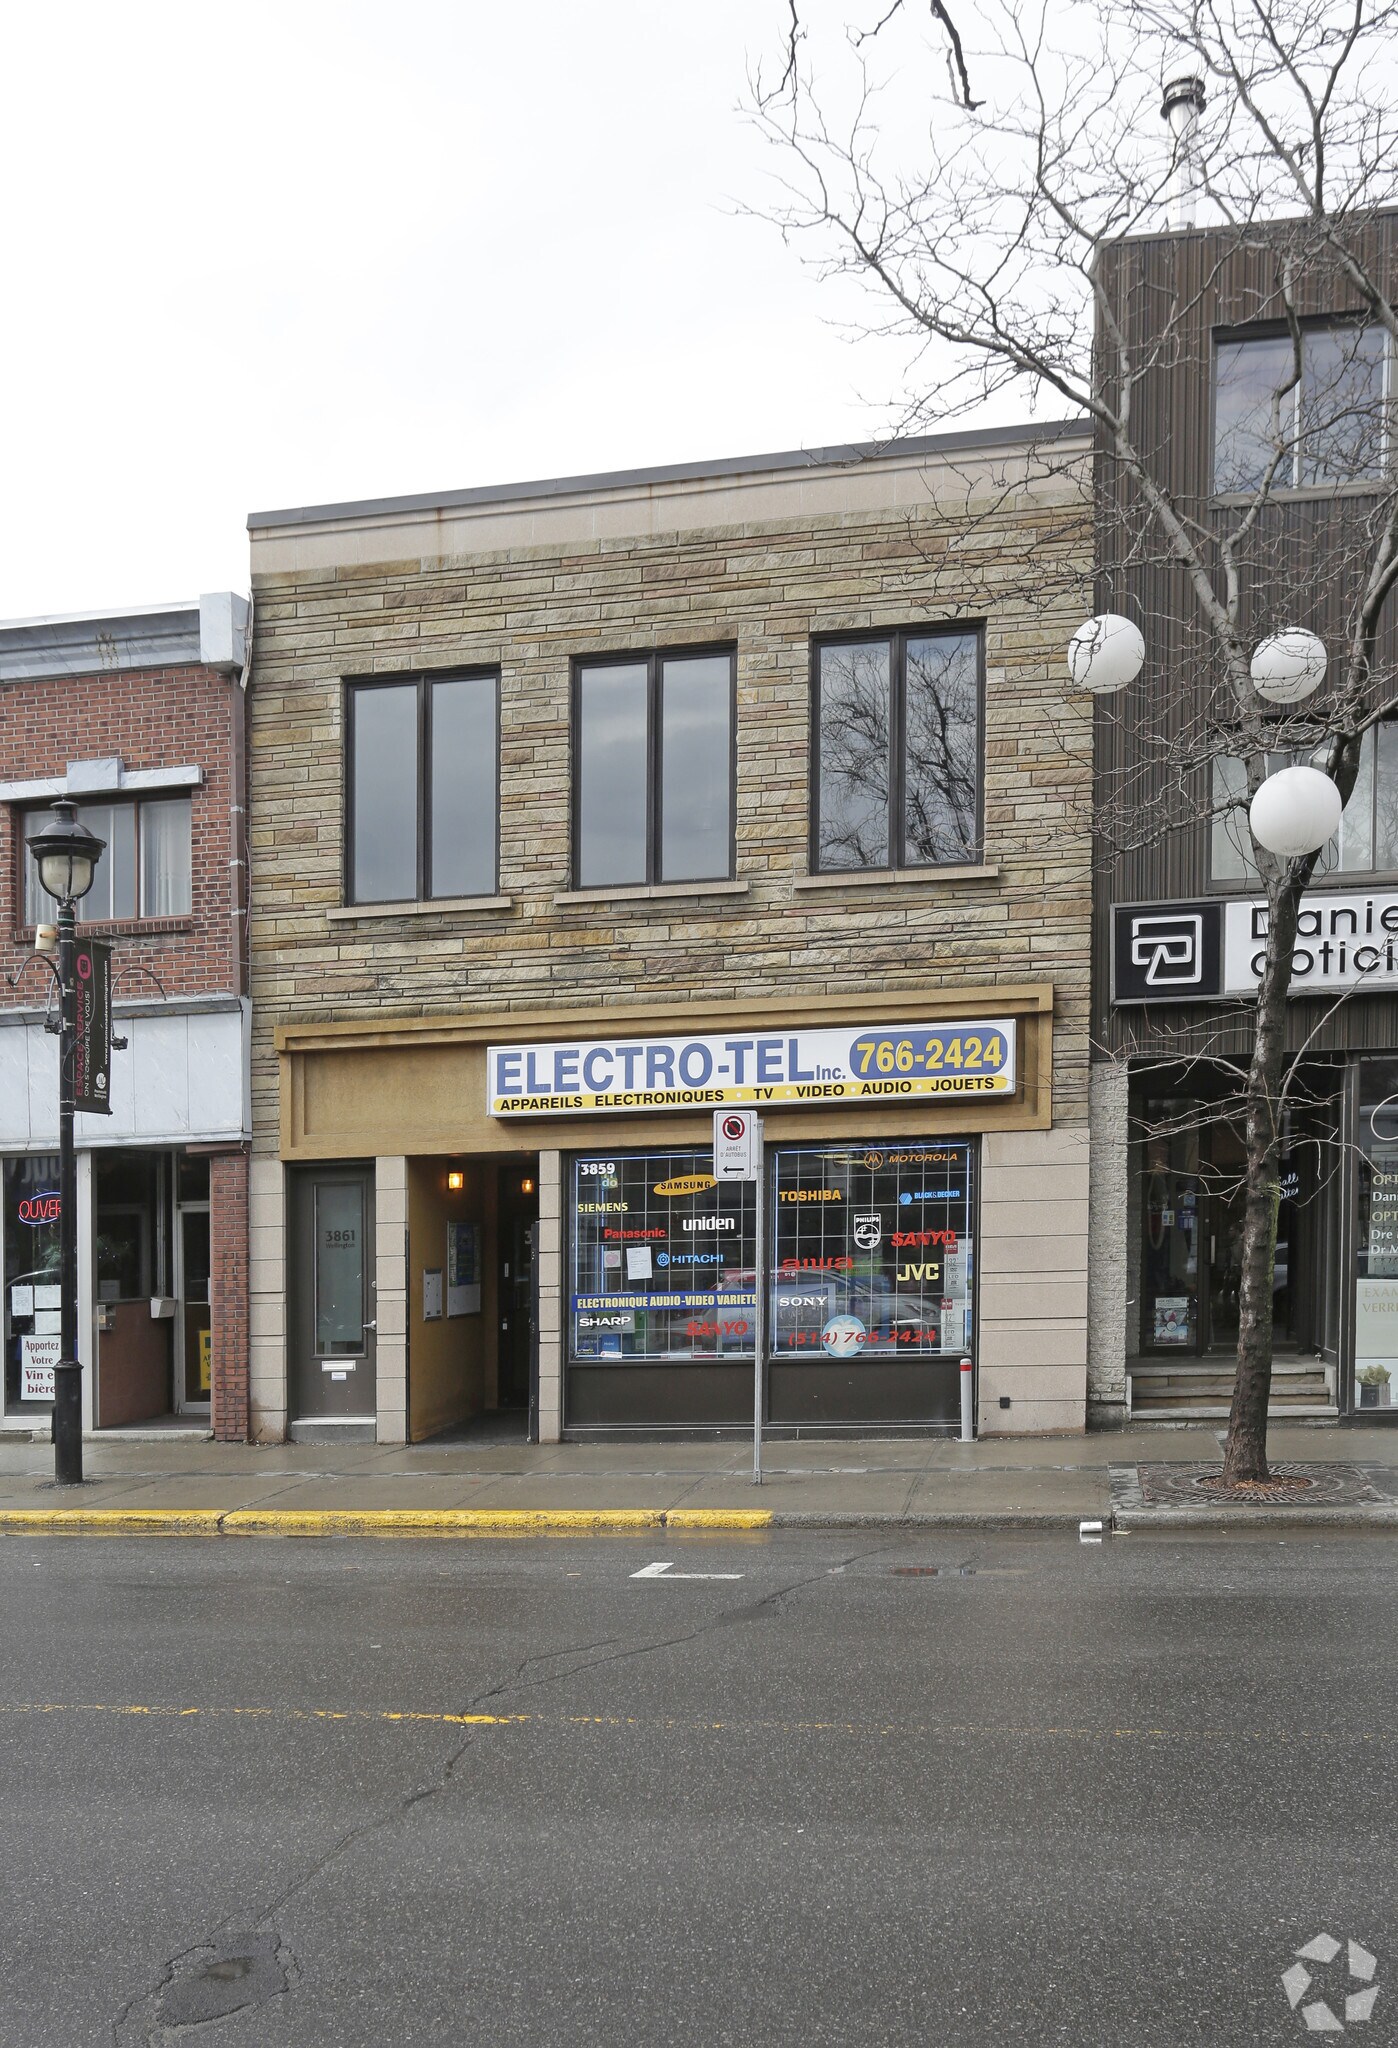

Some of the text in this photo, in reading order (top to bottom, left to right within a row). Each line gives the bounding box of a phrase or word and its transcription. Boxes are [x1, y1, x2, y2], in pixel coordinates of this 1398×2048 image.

[76, 1043, 84, 1096] ESPACE
[497, 1036, 1002, 1095] ELECTRO-TEL Inc. 766-2424
[84, 1083, 90, 1096] ON
[500, 1077, 995, 1111] APPAREILS ELECTRONIQUES TV VIDEO AUDIO JOUETS
[888, 1153, 958, 1163] MOTOROLA
[581, 1162, 616, 1176] 3859
[660, 1180, 711, 1190] SAMSUNG
[1372, 1174, 1398, 1186] OPT
[779, 1189, 842, 1201] TOSHIBA
[19, 1200, 61, 1218] OUVER
[577, 1202, 629, 1213] SIEMENS
[1371, 1211, 1398, 1222] OPT
[682, 1216, 735, 1231] uniden
[325, 1230, 355, 1241] 3861
[604, 1228, 665, 1239] Panasonic
[891, 1230, 956, 1247] SANYO
[1371, 1229, 1393, 1240] Dre
[1371, 1245, 1386, 1255] Dr
[672, 1254, 723, 1263] HITACHI
[782, 1256, 854, 1271] aiwa
[897, 1263, 939, 1281] JVC
[577, 1296, 648, 1309] ELECTRONIQUE
[779, 1296, 828, 1307] SONY
[579, 1316, 632, 1327] SHARP
[687, 1320, 748, 1337] SANYO
[788, 1332, 837, 1346] (514)
[845, 1330, 938, 1343] 766-2424
[25, 1341, 60, 1353] Apportez
[31, 1356, 54, 1365] Votre
[25, 1370, 54, 1380] Vin e
[27, 1383, 56, 1394] bière
